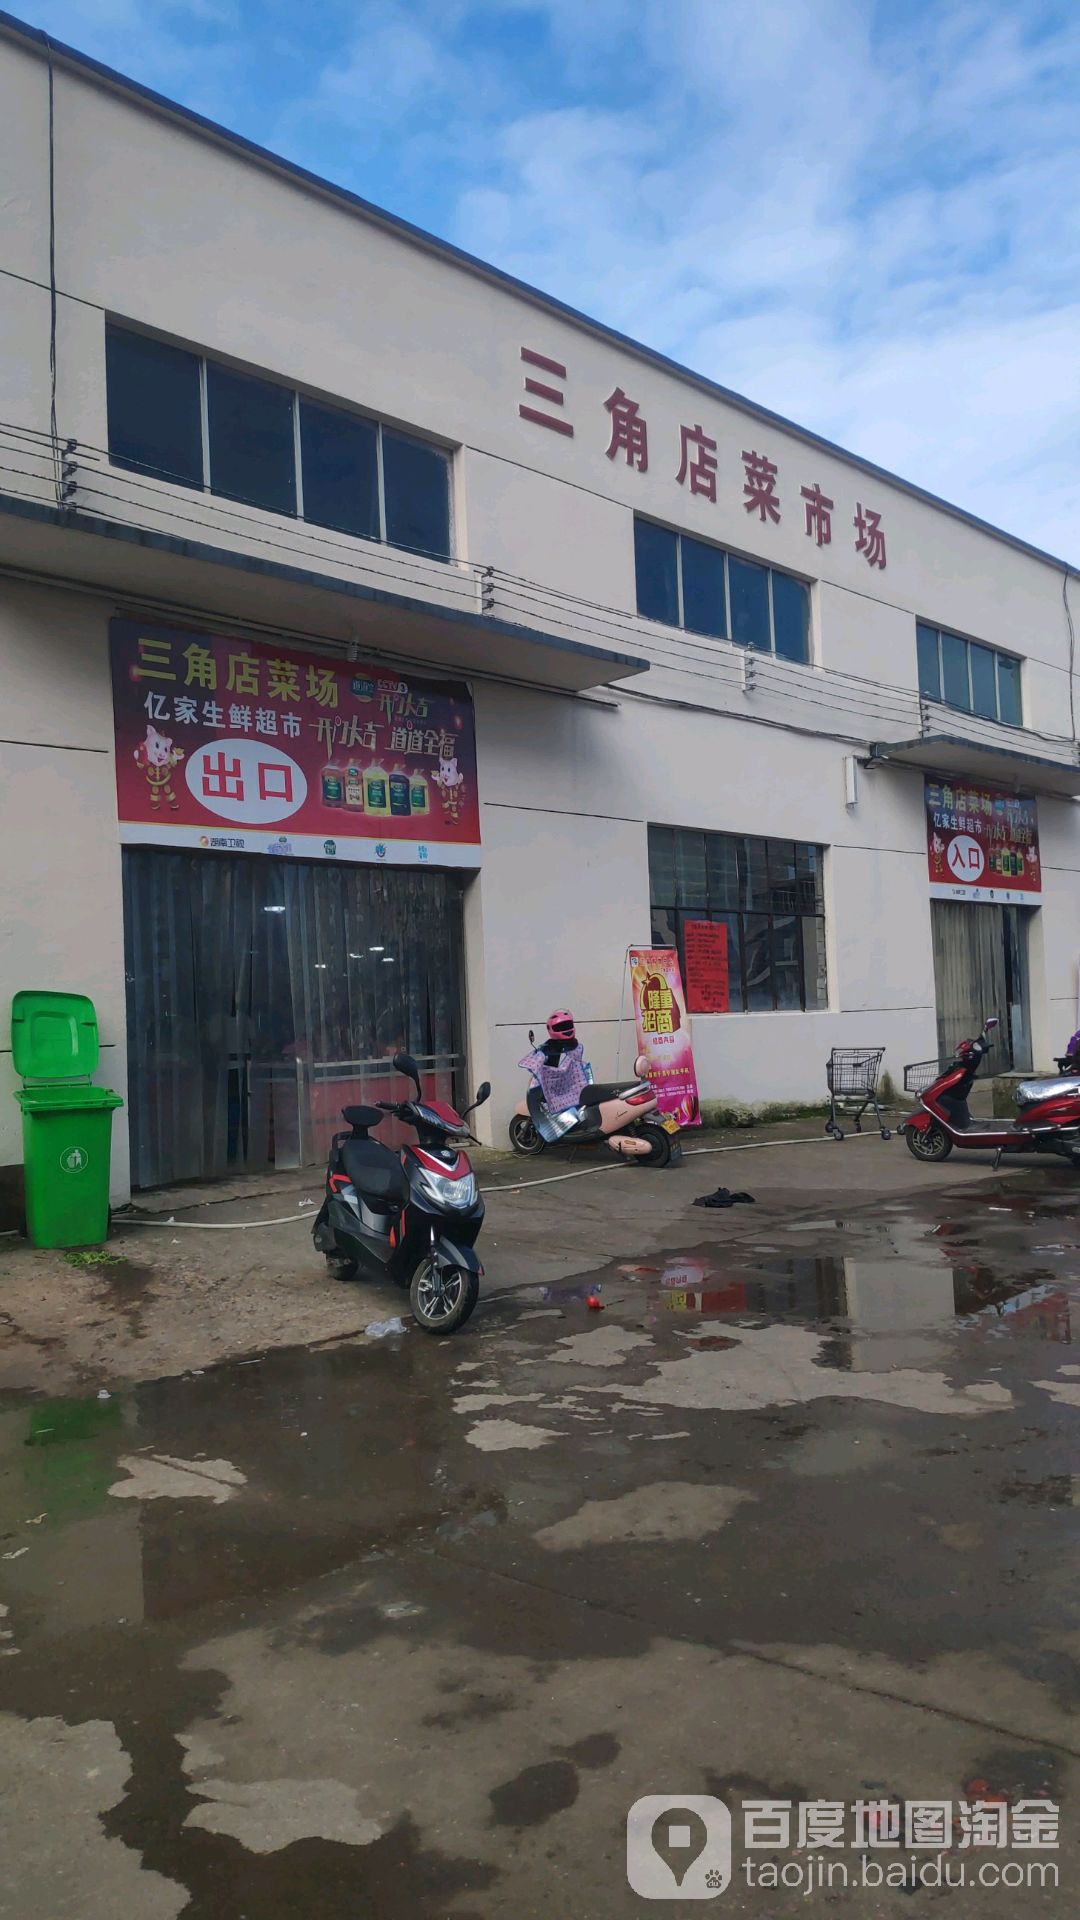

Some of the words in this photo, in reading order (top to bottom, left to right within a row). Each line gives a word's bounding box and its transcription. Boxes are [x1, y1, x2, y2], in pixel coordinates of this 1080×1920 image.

[519, 347, 887, 570] 三角店菜市场
[135, 638, 339, 708] 三角店菜场
[143, 690, 302, 738] 亿家生鲜超市
[202, 752, 294, 802] 出口
[928, 784, 992, 816] 三角店菜场
[933, 812, 982, 834] 亿家生鲜超市
[951, 844, 980, 869] 入口
[647, 990, 673, 1009] 隆重
[642, 1009, 673, 1033] 招商
